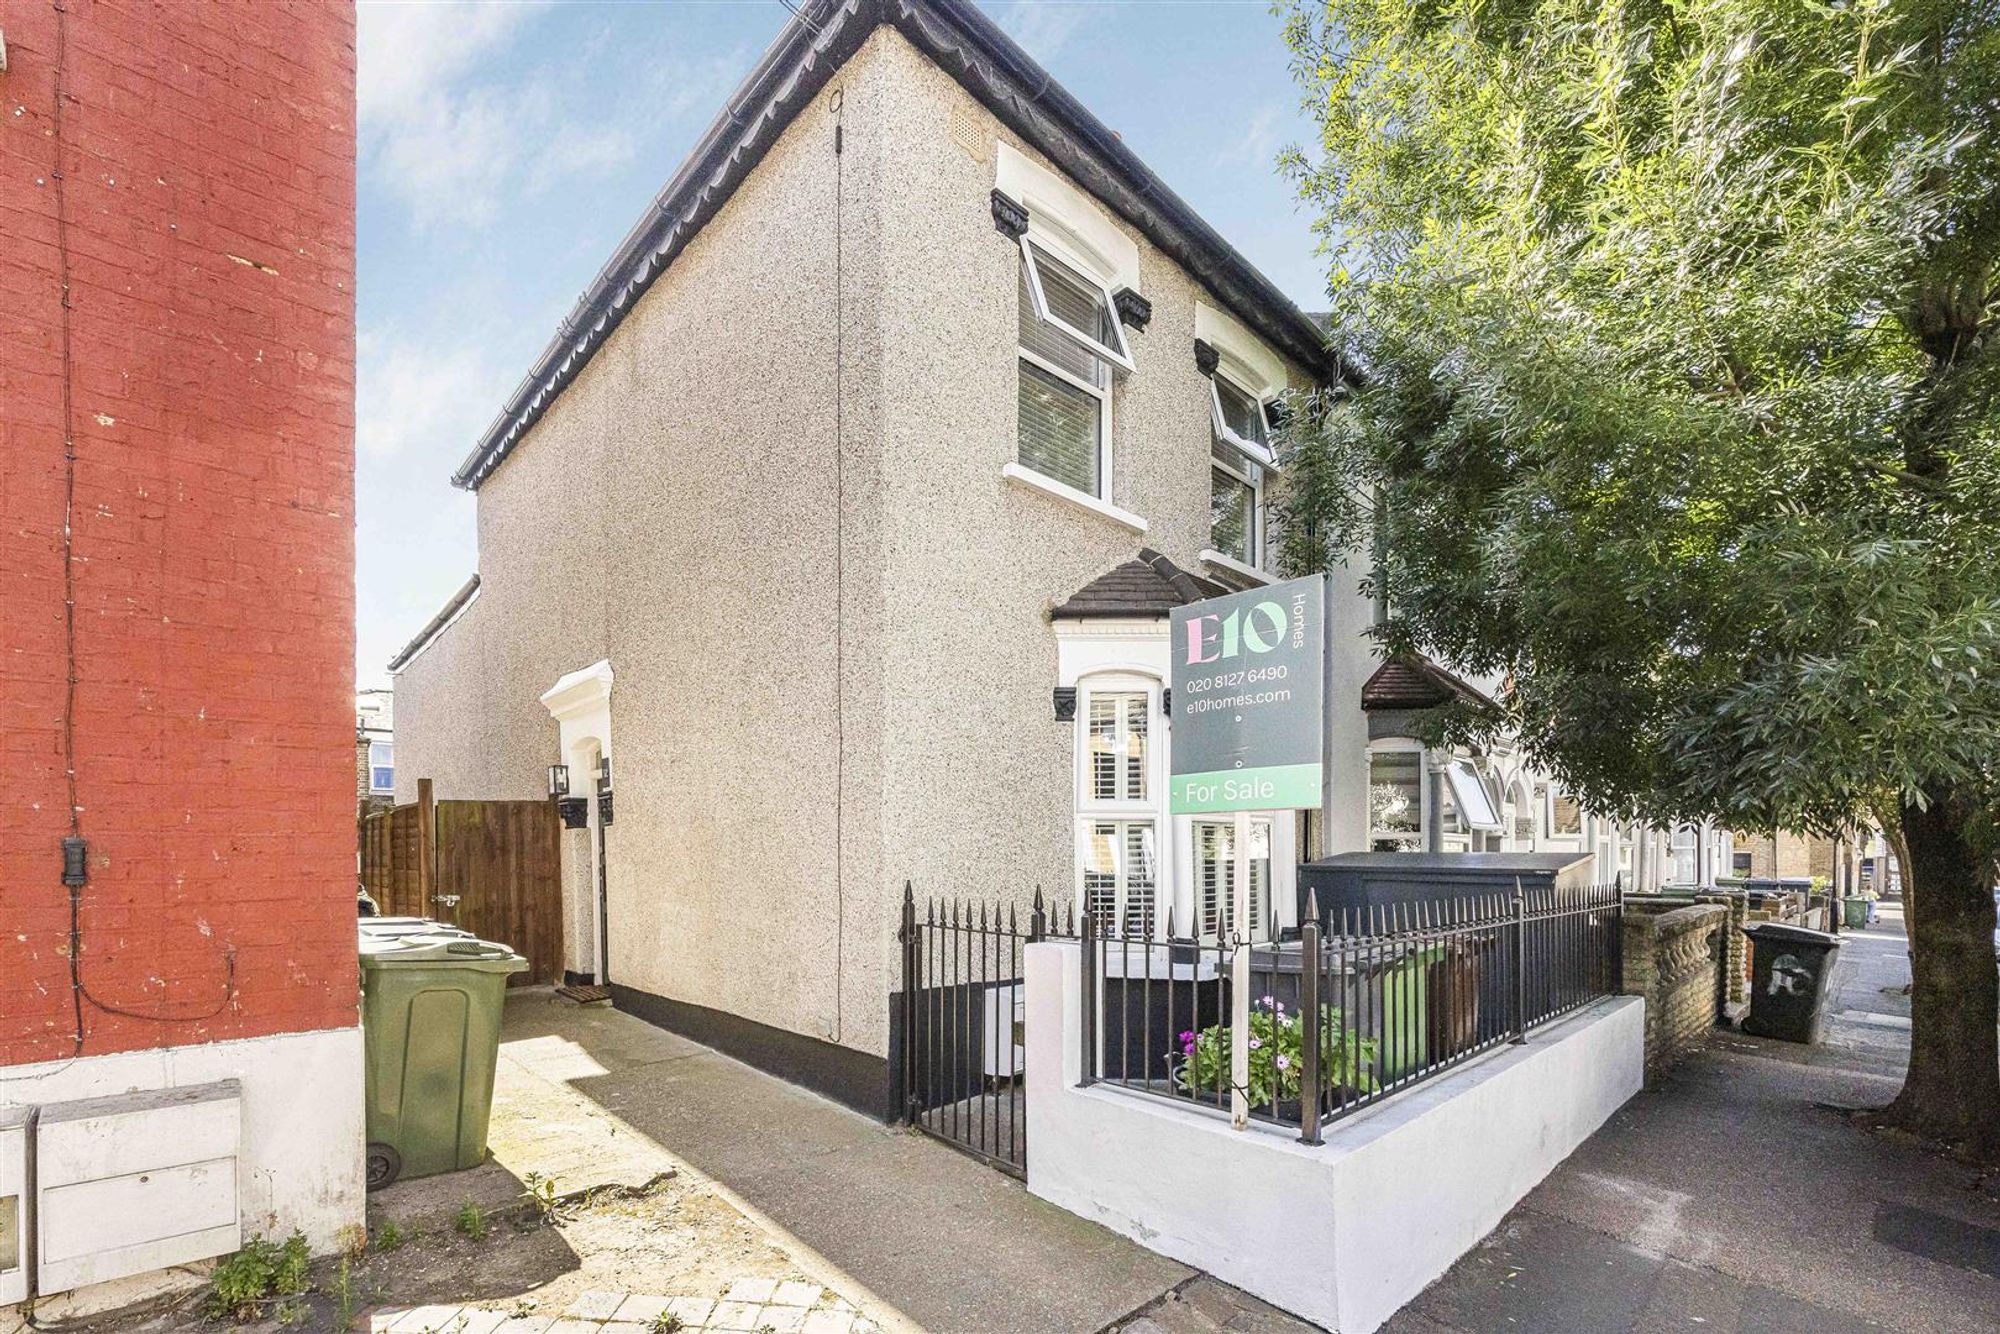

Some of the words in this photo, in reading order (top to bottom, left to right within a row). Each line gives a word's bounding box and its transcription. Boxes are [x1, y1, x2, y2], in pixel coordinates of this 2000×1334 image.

[1186, 601, 1288, 665] E10
[1293, 592, 1306, 650] Homes
[1187, 678, 1212, 694] 020
[1214, 671, 1245, 689] 8127
[1247, 665, 1288, 683] 6490
[1187, 689, 1291, 714] e10homes.com
[1186, 783, 1218, 803] For
[1223, 777, 1275, 801] Sale
